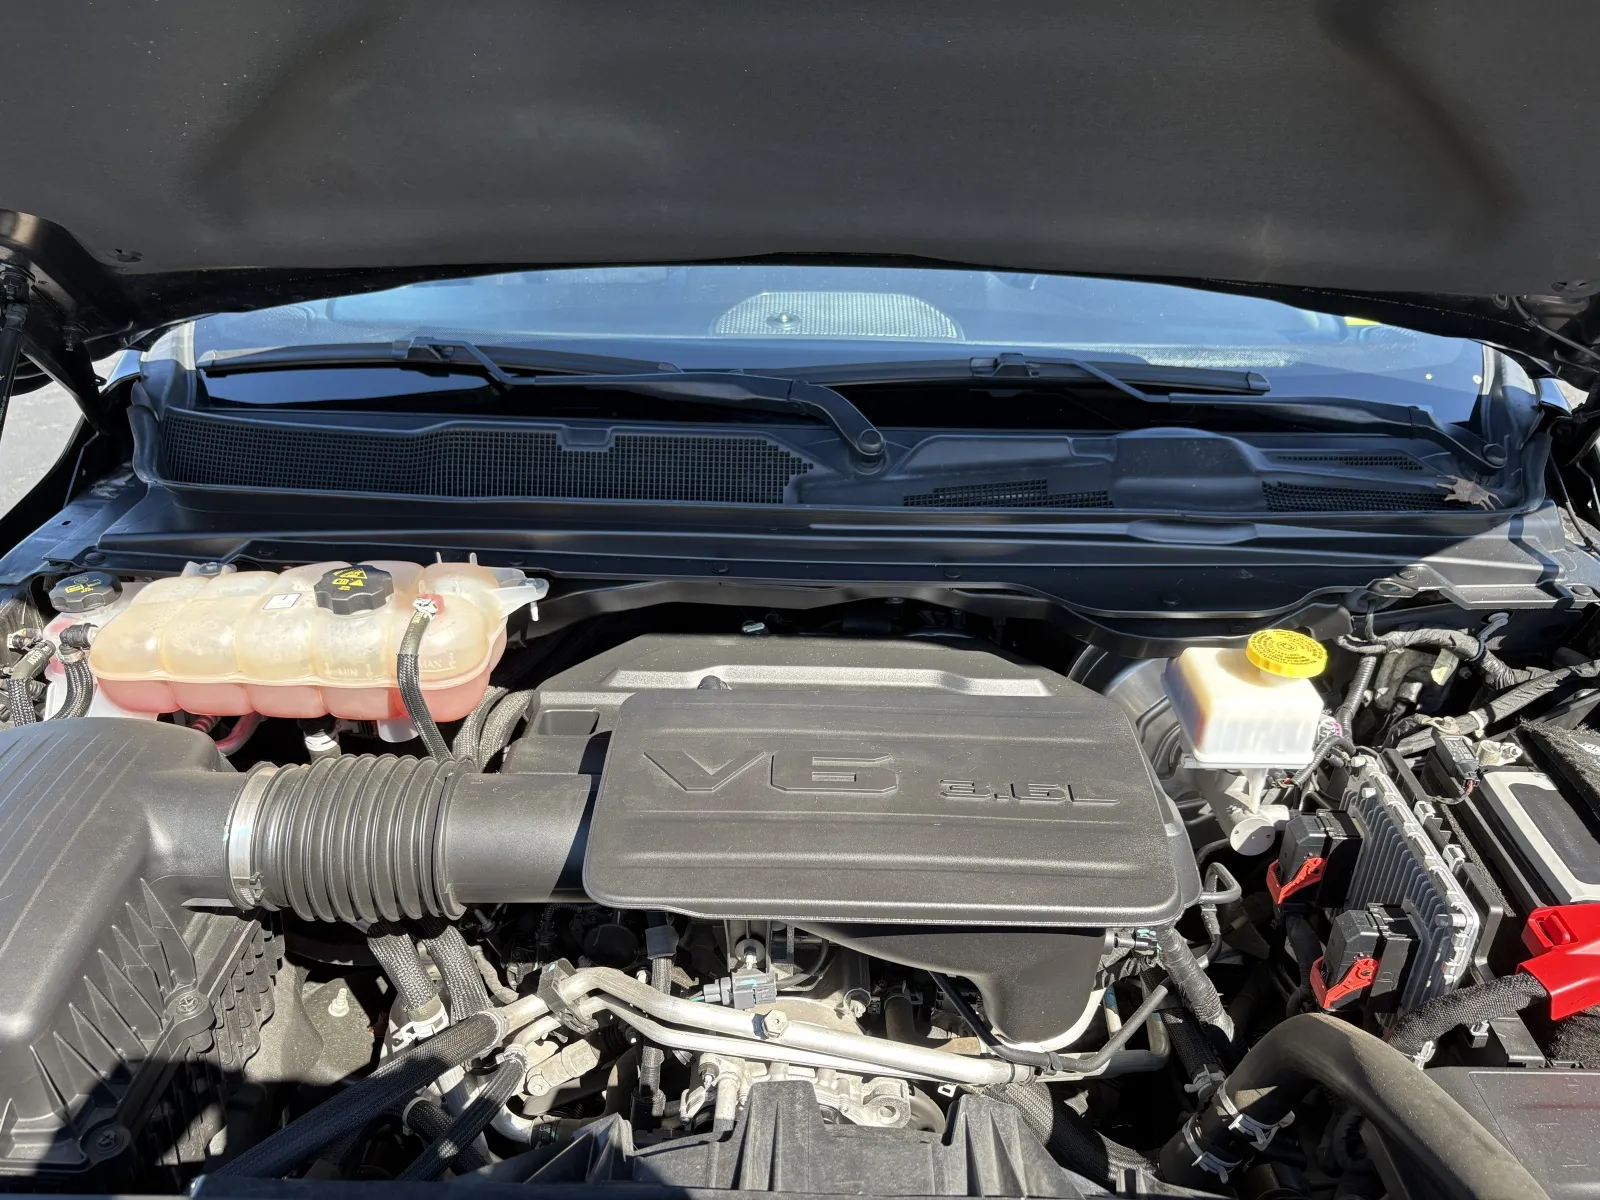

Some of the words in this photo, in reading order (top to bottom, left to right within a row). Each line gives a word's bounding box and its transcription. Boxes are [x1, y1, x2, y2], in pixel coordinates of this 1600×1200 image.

[337, 667, 358, 677] MIN
[643, 749, 898, 794] V6
[939, 779, 1121, 806] 3.6L
